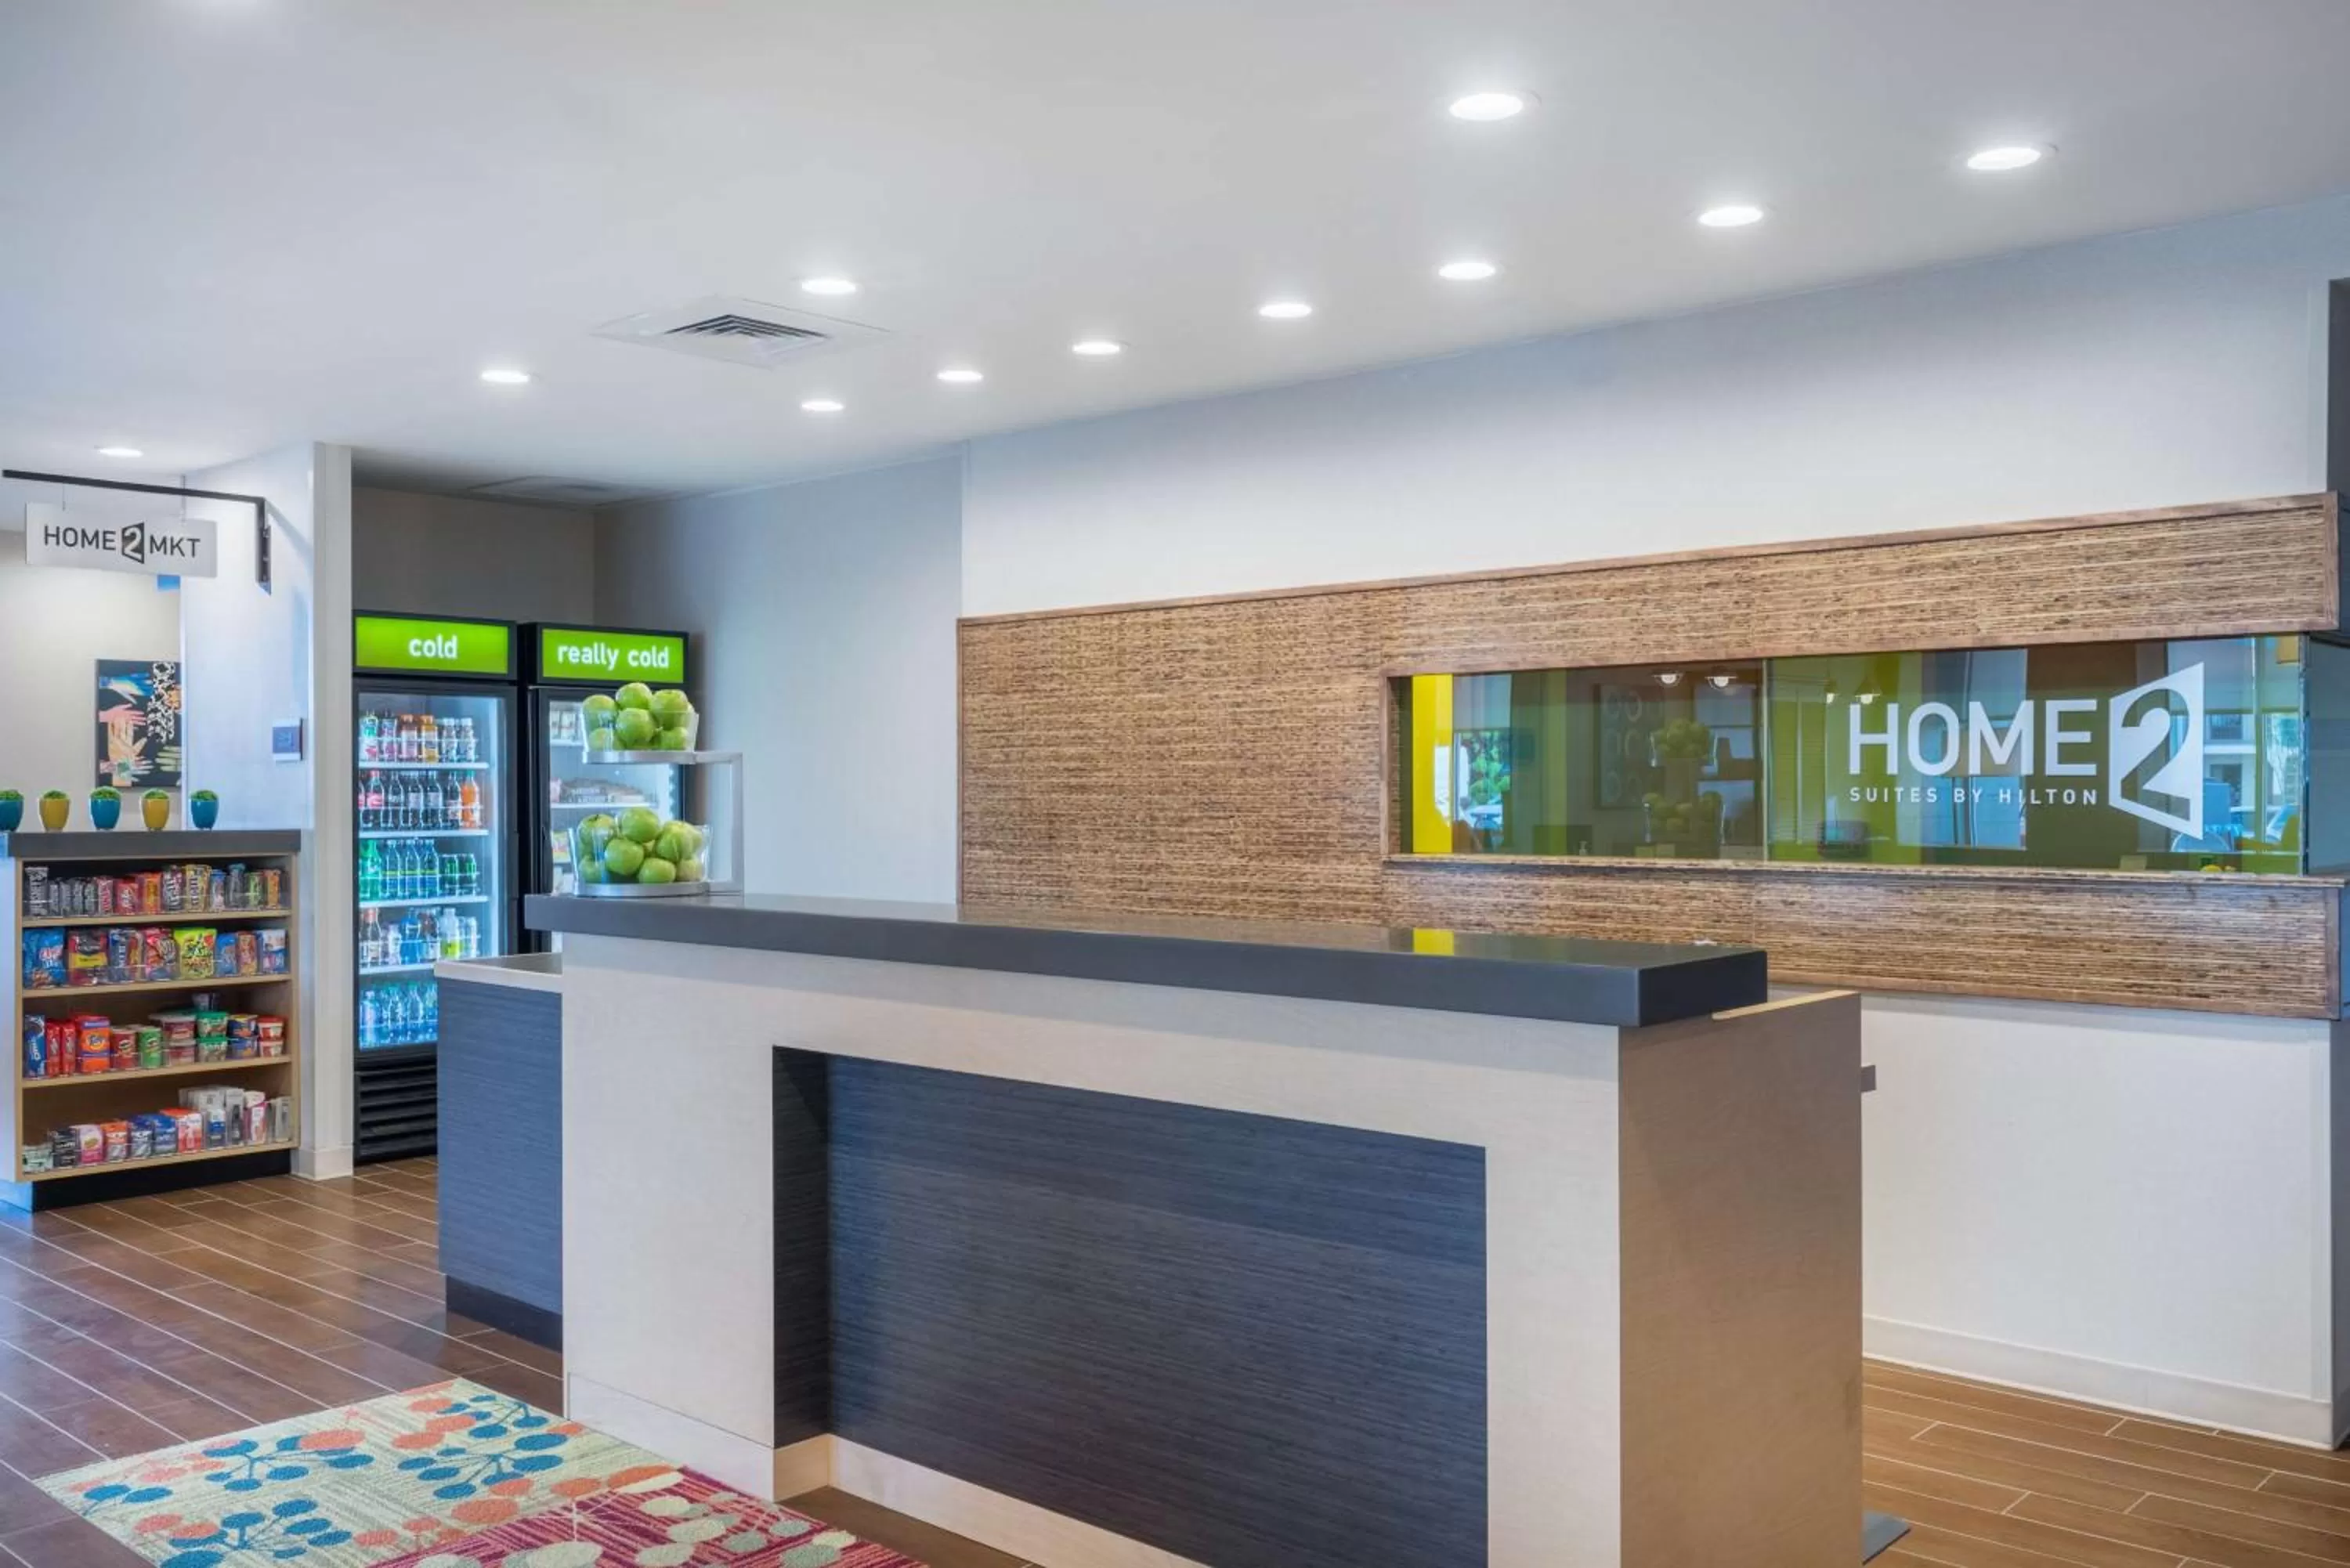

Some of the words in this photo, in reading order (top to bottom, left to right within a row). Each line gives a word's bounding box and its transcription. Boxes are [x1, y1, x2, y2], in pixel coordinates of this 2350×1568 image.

[44, 524, 117, 551] HOME
[150, 534, 201, 558] MKT
[408, 634, 458, 659] cold
[557, 642, 619, 670] really
[627, 645, 670, 668] cold
[1848, 699, 2098, 776] HOME
[2118, 683, 2193, 824] 2
[1849, 786, 1938, 803] SUITES
[1954, 788, 1983, 804] BY
[1998, 788, 2098, 805] HILTON
